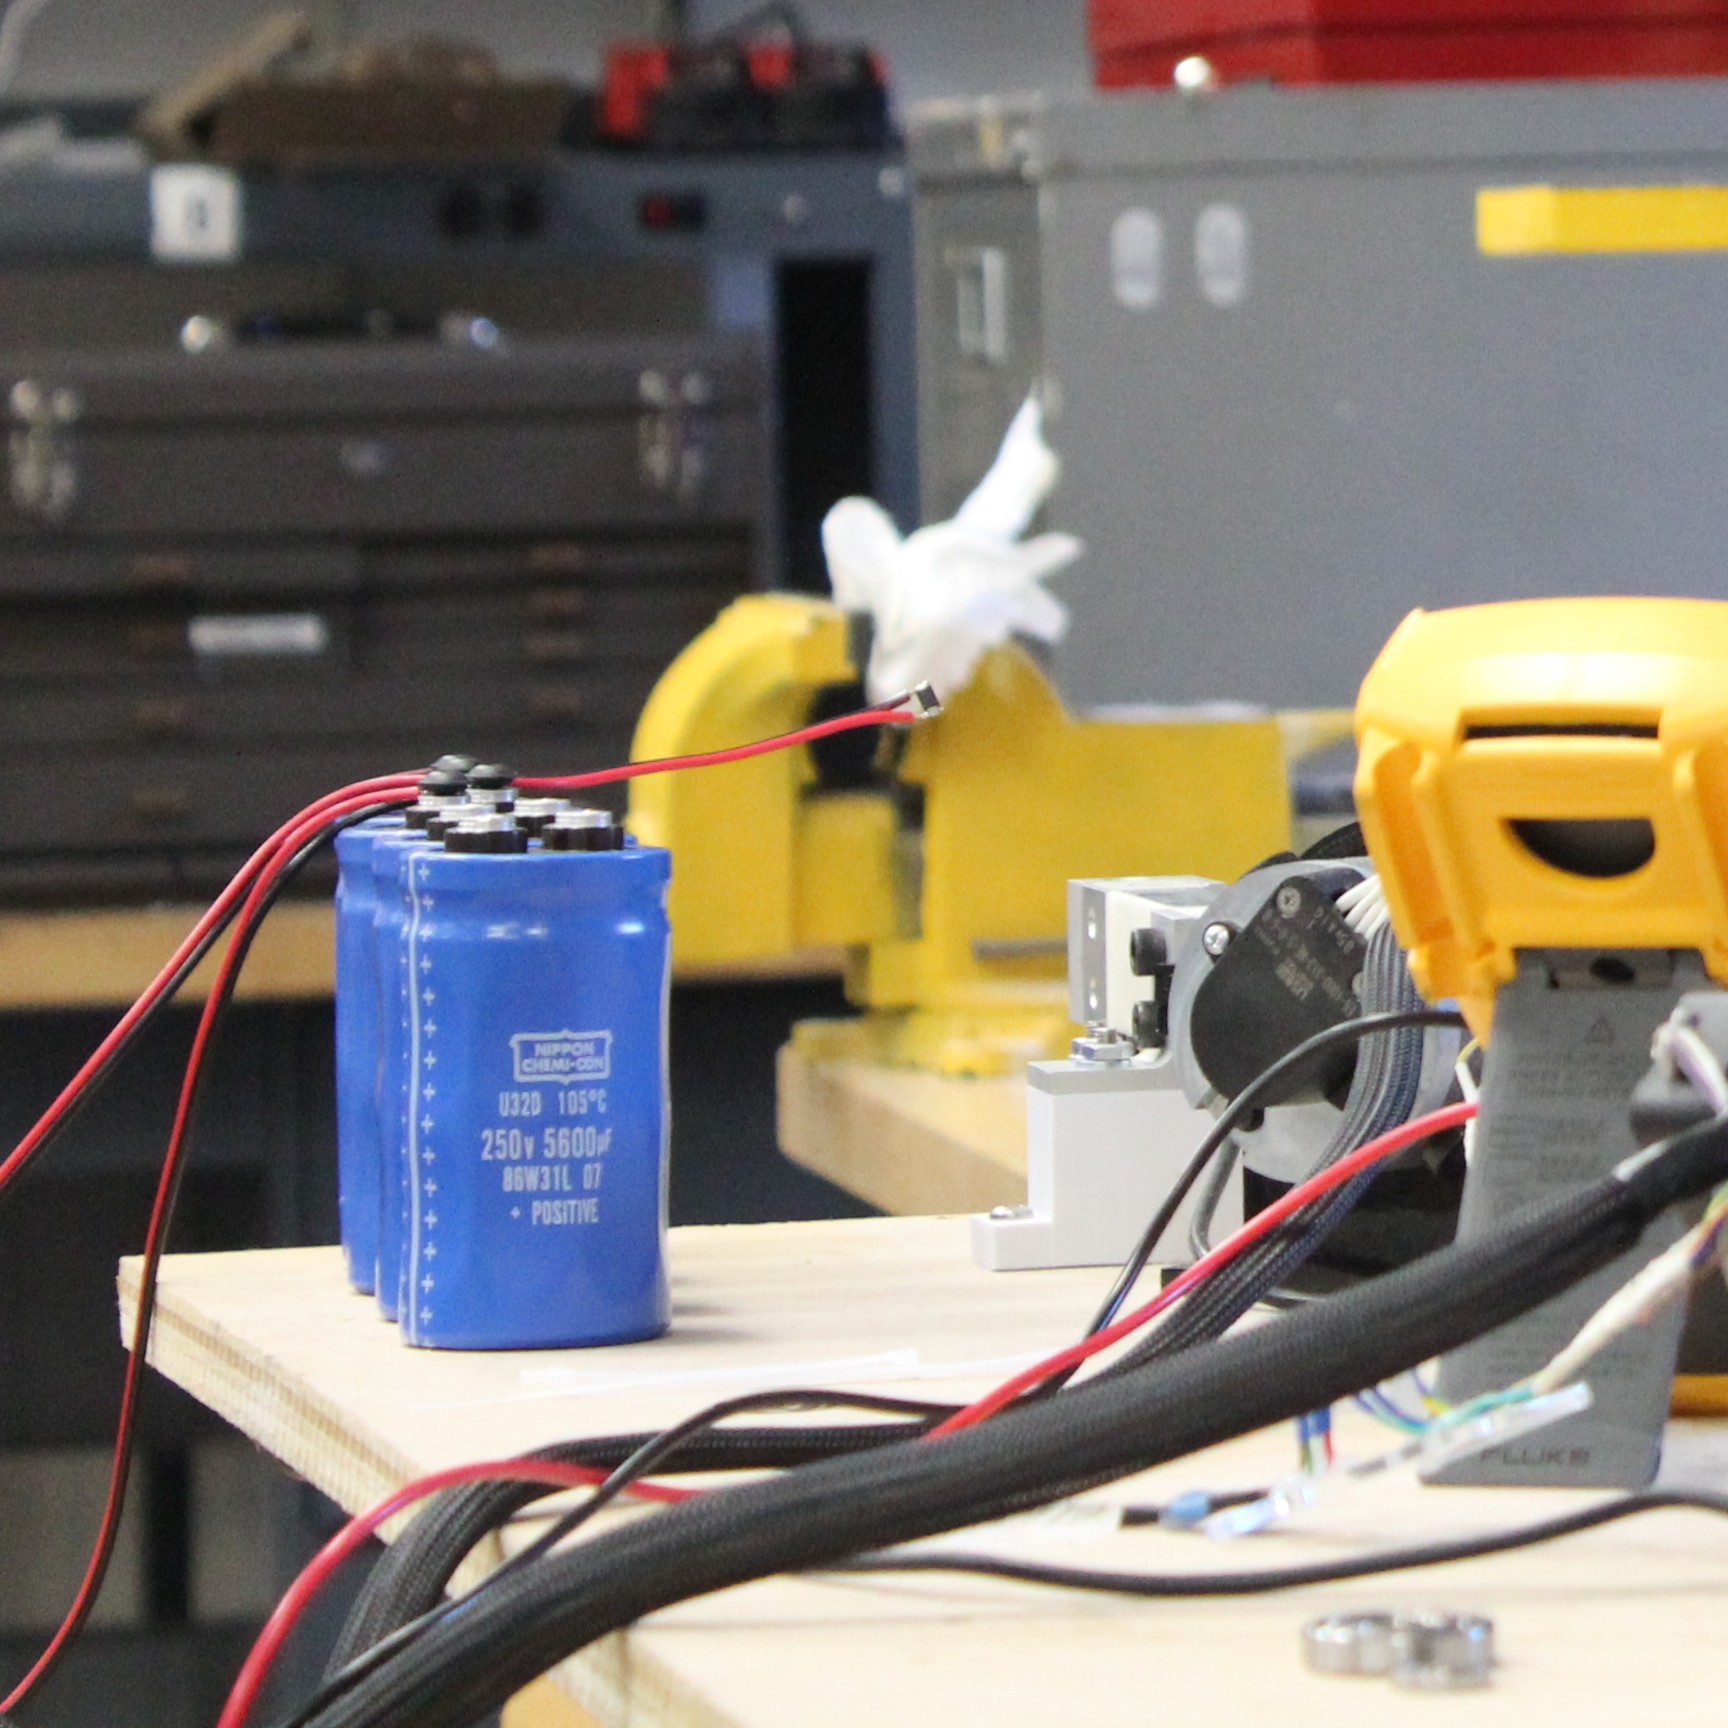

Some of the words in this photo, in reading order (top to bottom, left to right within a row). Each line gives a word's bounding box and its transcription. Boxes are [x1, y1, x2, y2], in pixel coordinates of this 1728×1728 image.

[535, 1041, 595, 1057] NIPPON
[521, 1056, 605, 1072] CHEMI-CON
[499, 1091, 541, 1117] U32D
[532, 1198, 599, 1225] POSITIVE
